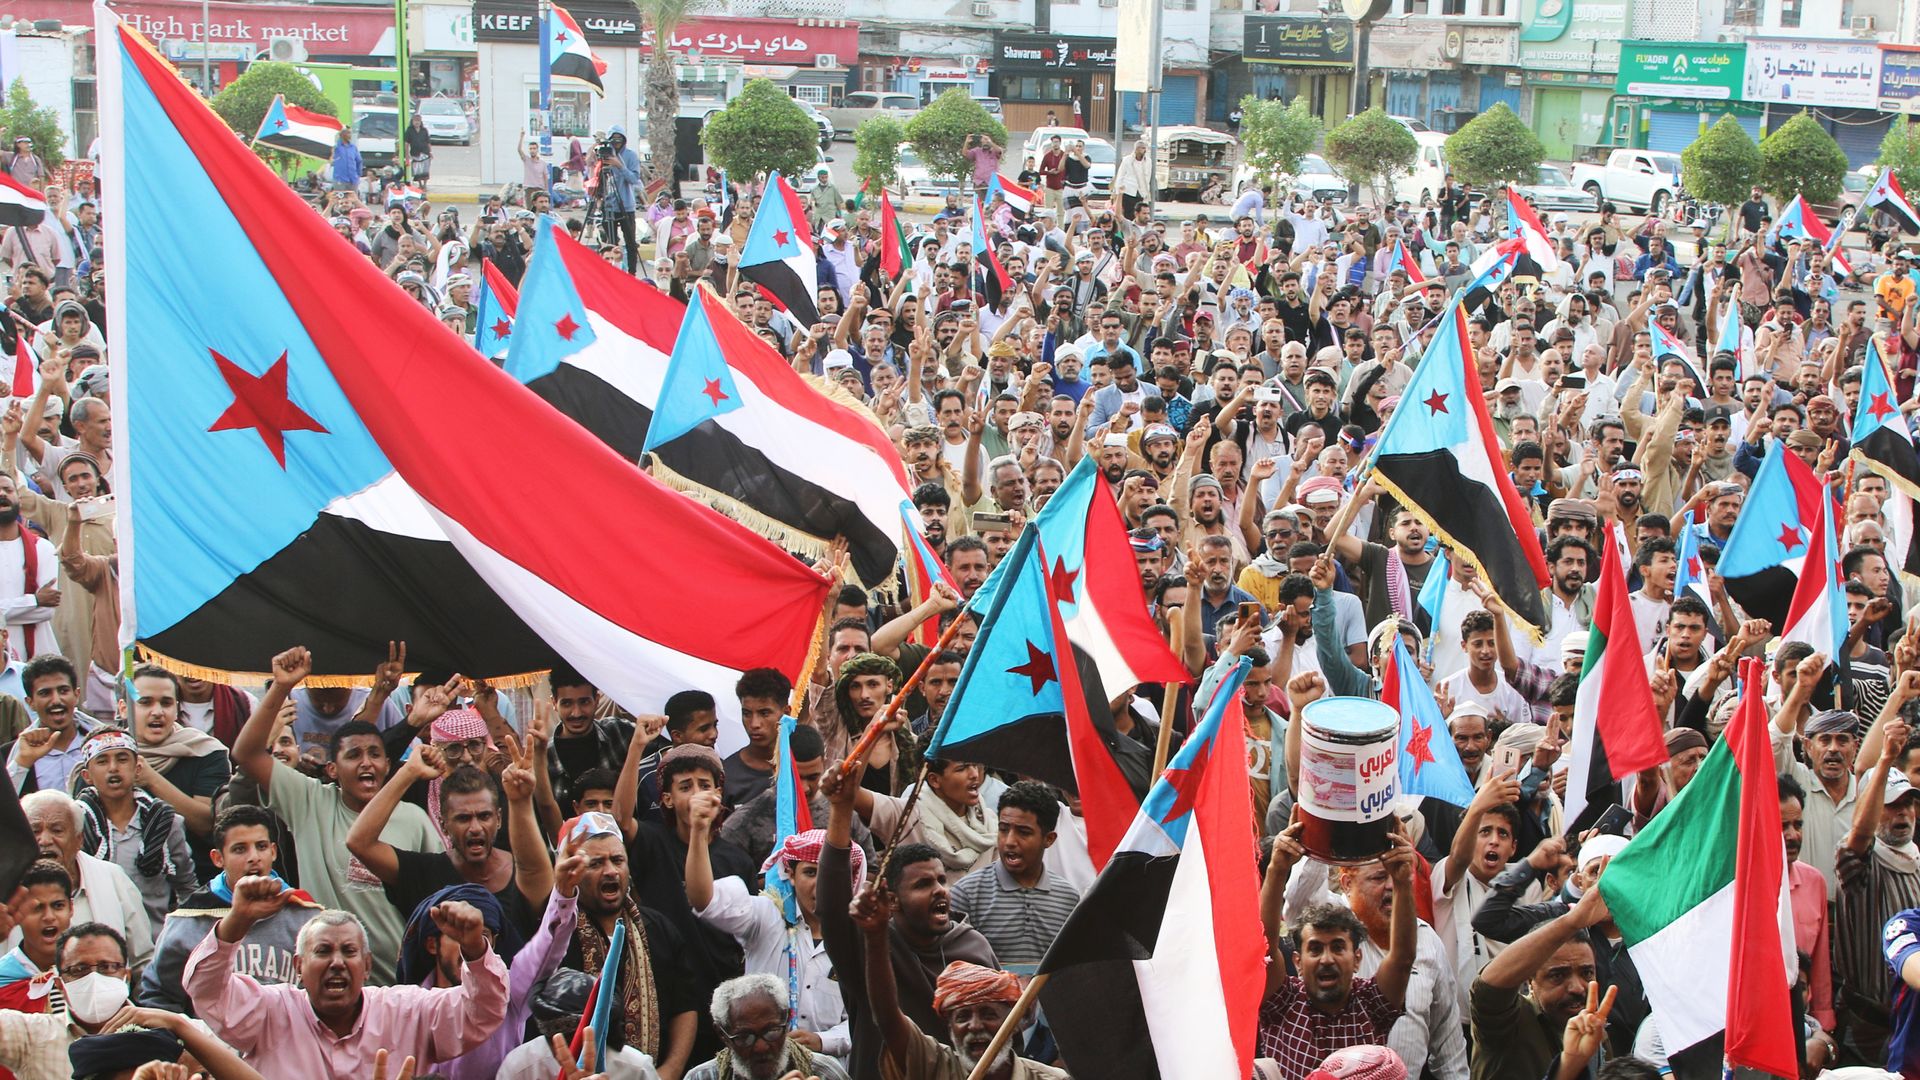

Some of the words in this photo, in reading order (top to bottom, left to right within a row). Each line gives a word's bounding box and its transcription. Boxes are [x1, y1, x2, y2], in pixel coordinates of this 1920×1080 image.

[121, 14, 186, 40] High
[190, 20, 253, 42] park
[260, 24, 349, 43] market
[481, 14, 533, 31] KEEF
[585, 17, 636, 34] كييف
[698, 33, 761, 53] بارك
[764, 34, 808, 56] هاي
[1636, 55, 1668, 64] FLYADEN
[1764, 57, 1816, 80] للتجارة
